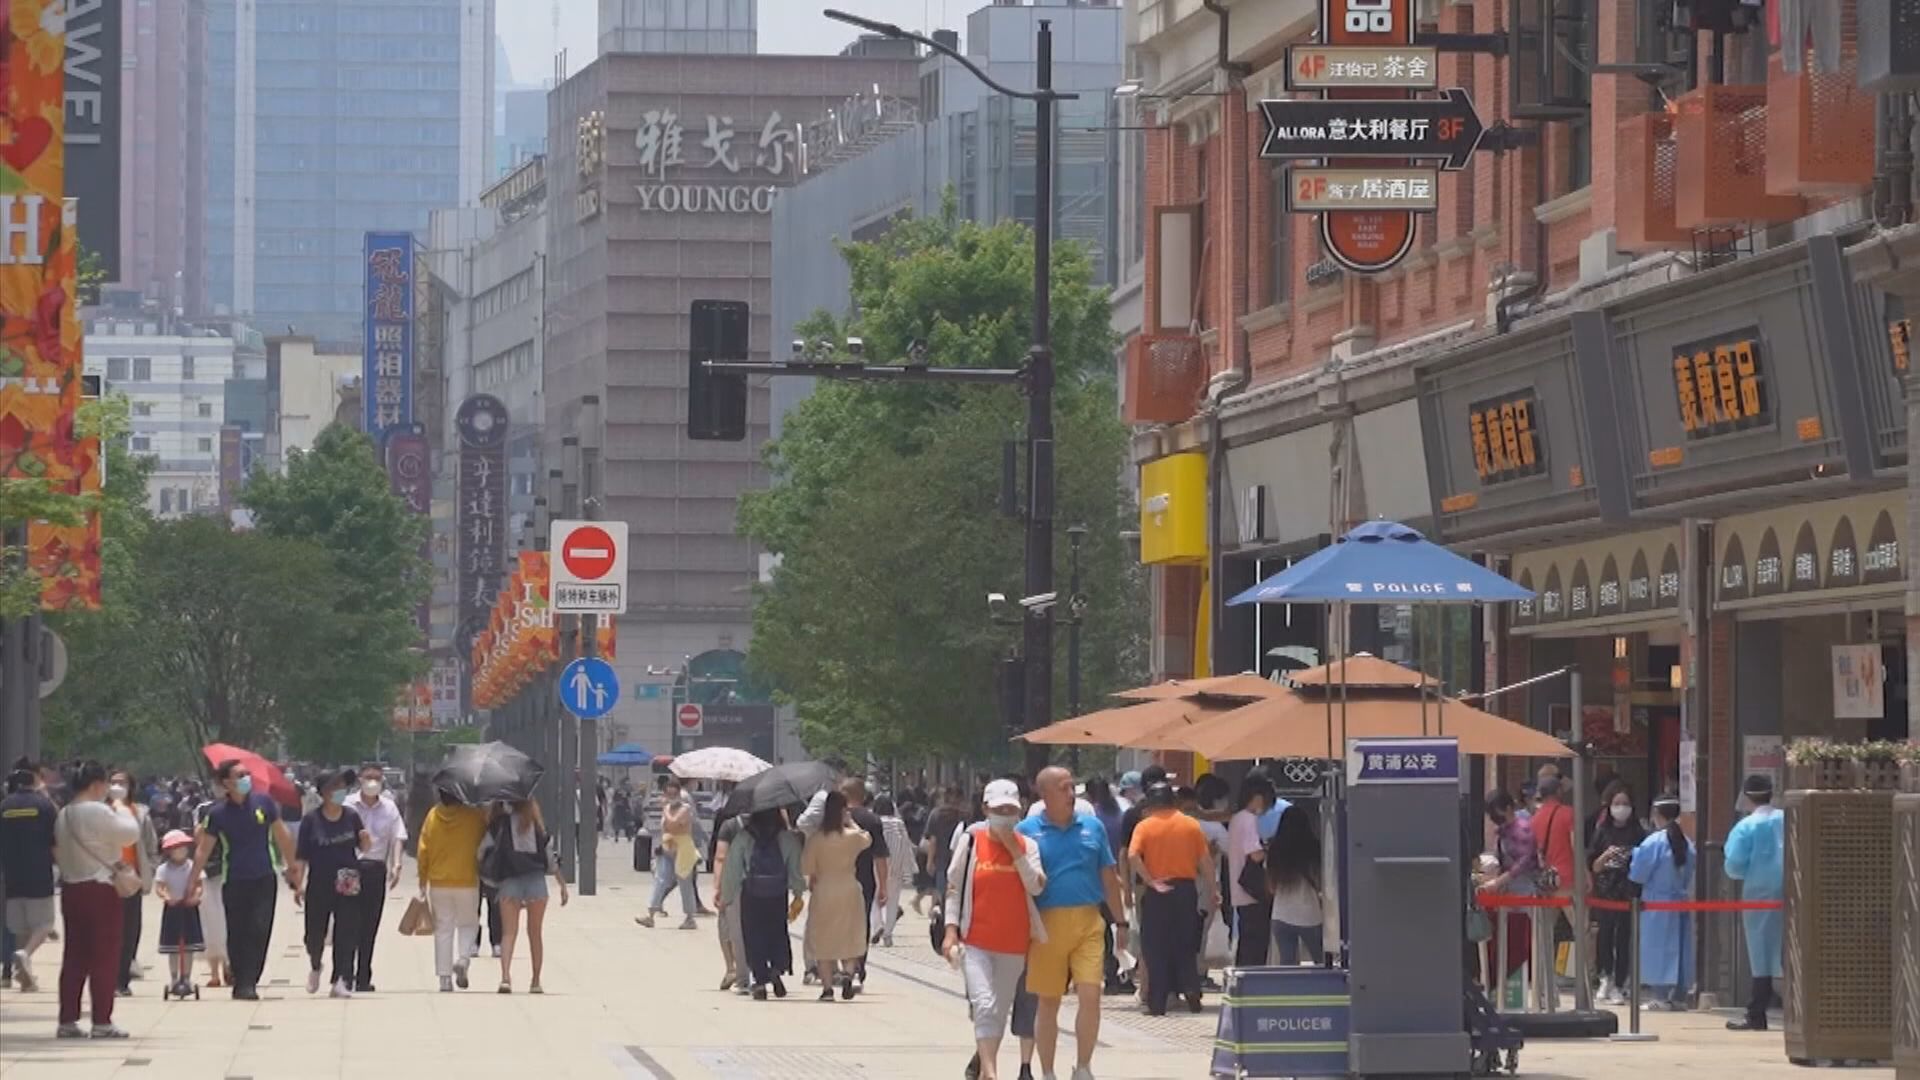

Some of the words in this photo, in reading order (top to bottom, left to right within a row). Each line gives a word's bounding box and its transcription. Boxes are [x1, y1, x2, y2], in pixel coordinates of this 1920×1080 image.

[1298, 55, 1326, 79] 4F
[1383, 56, 1429, 79] 茶舍
[1277, 126, 1326, 140] ALLORA
[1327, 118, 1430, 141] 意大利餐厅
[1438, 119, 1465, 139] 3F
[1299, 177, 1327, 201] 2F
[1373, 582, 1448, 594] POLICE
[1367, 754, 1438, 770] 黄浦公安
